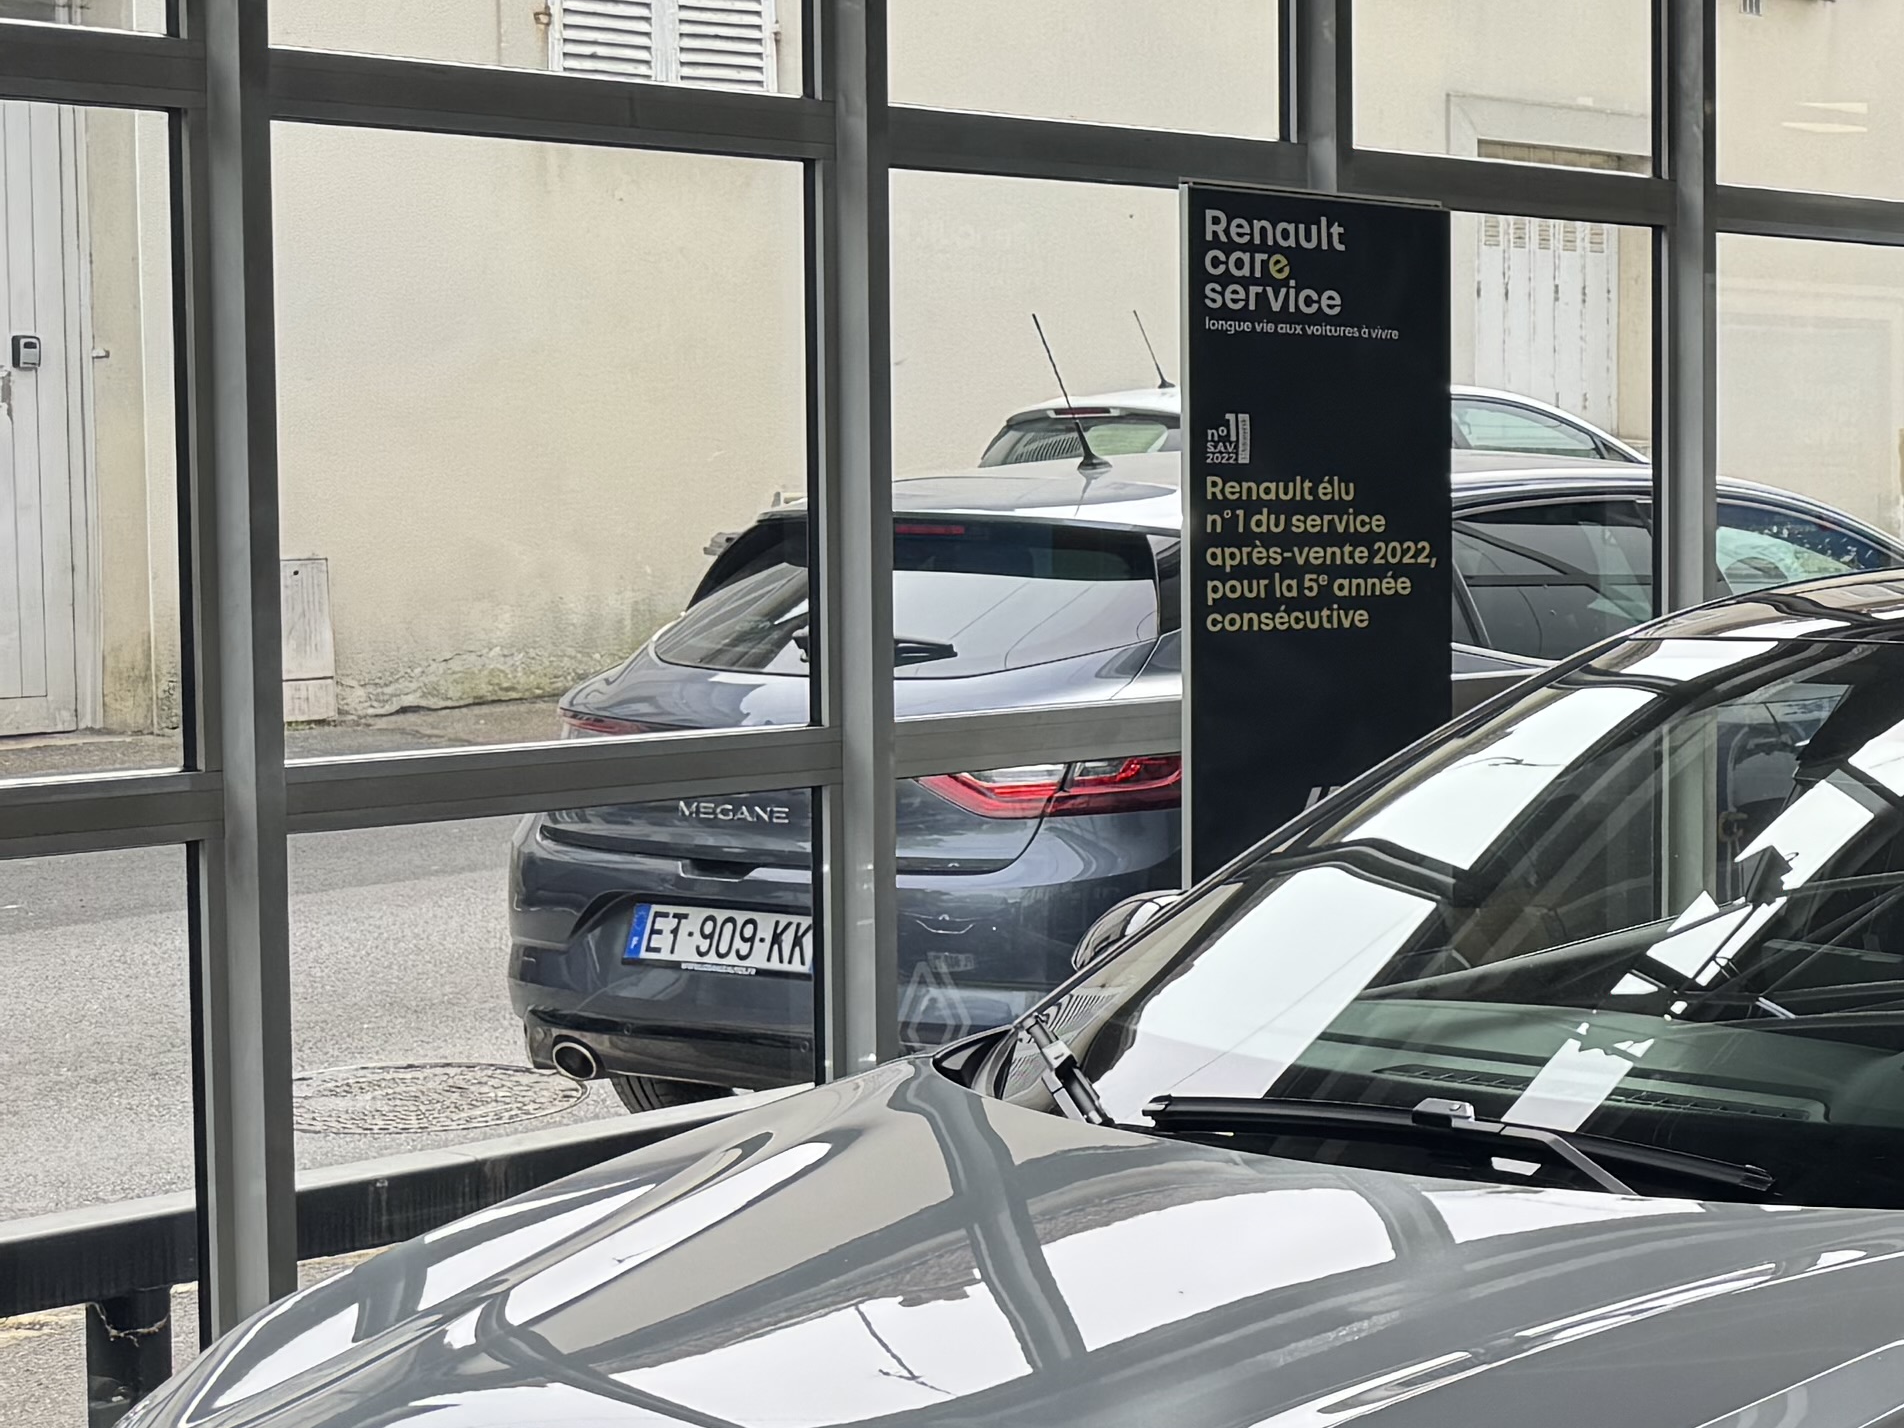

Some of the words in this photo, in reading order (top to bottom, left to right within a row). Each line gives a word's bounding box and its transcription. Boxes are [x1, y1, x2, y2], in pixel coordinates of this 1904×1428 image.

[1205, 209, 1346, 252] Renault
[1204, 249, 1290, 280] care
[1204, 279, 1342, 316] service
[1205, 316, 1252, 335] longue
[1255, 319, 1275, 333] vie
[1277, 324, 1302, 335] aux
[1305, 322, 1359, 338] voitures
[1362, 324, 1369, 338] à
[1370, 326, 1399, 340] vivre
[1206, 453, 1237, 464] 2022
[1206, 476, 1313, 501] Renault
[1318, 476, 1355, 501] élu
[1250, 508, 1285, 533] du
[1291, 508, 1386, 533] service
[1206, 540, 1369, 573] après-vente
[1373, 541, 1437, 568] 2022,
[1206, 579, 1269, 606] pour
[1275, 572, 1298, 598] la
[1333, 571, 1412, 597] année
[1206, 604, 1369, 632] consécutive
[677, 800, 790, 825] MEGANE
